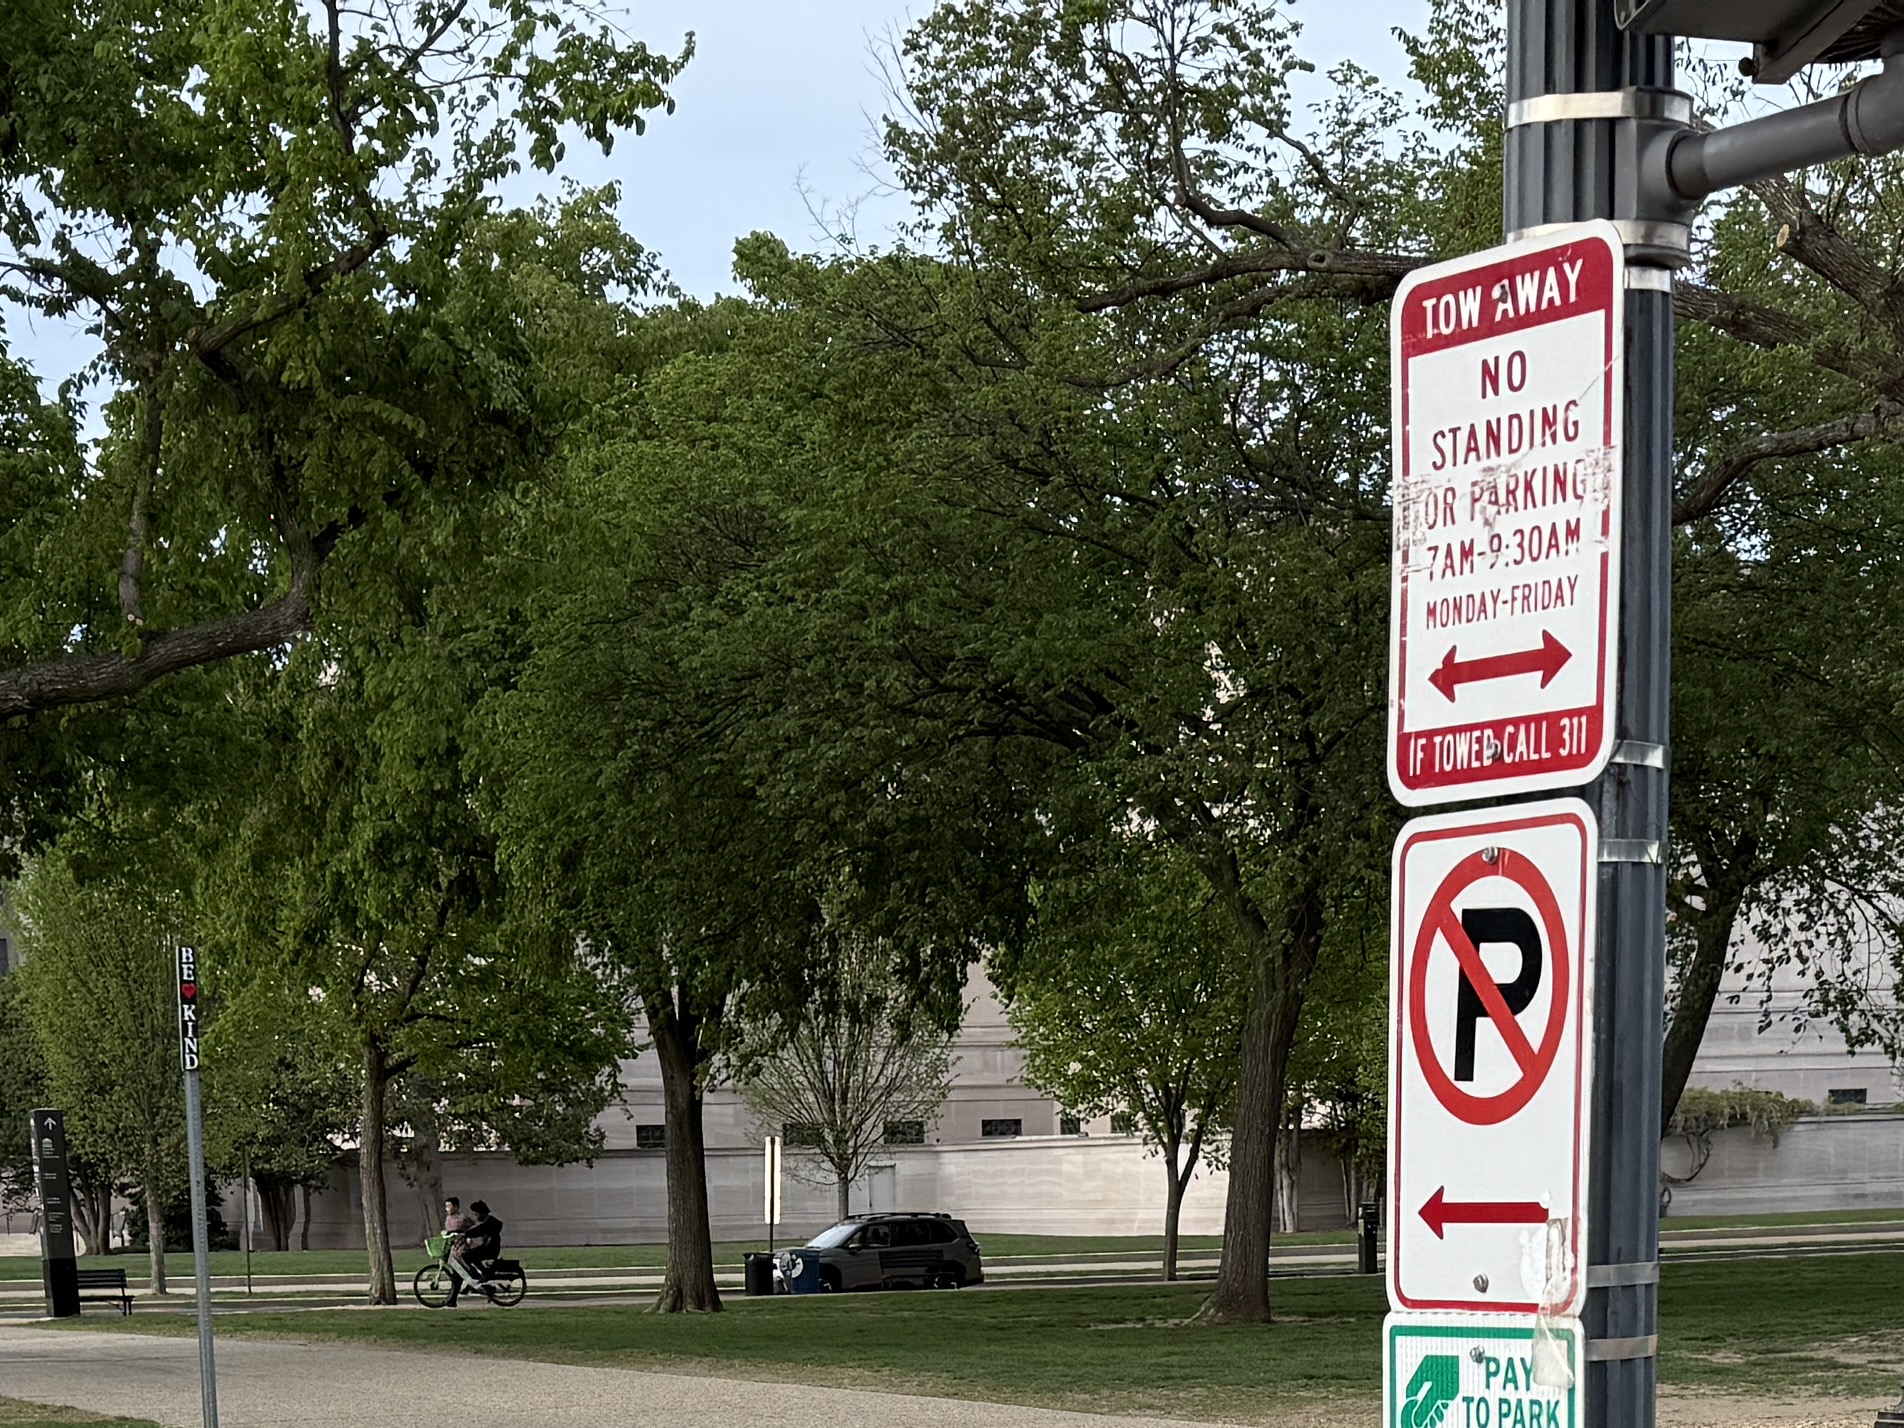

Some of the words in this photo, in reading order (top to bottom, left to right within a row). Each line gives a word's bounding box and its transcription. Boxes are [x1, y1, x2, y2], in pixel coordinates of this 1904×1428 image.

[1422, 286, 1482, 338] TOW
[1492, 258, 1583, 322] AWAY
[1482, 350, 1526, 399] NO
[1432, 400, 1579, 471] STANDING
[1425, 486, 1456, 529] OR
[1471, 459, 1585, 521] PARKING
[1427, 517, 1581, 581] 7AM-9:30AM
[1427, 574, 1579, 630] MONDAY-FRIDAY
[1409, 734, 1426, 776] IF
[1434, 728, 1497, 772] TOWED
[1503, 720, 1551, 764] CALL
[1559, 715, 1587, 756] 311
[181, 947, 194, 980] BE
[182, 1004, 198, 1070] KIND
[1484, 1356, 1534, 1391] PAY
